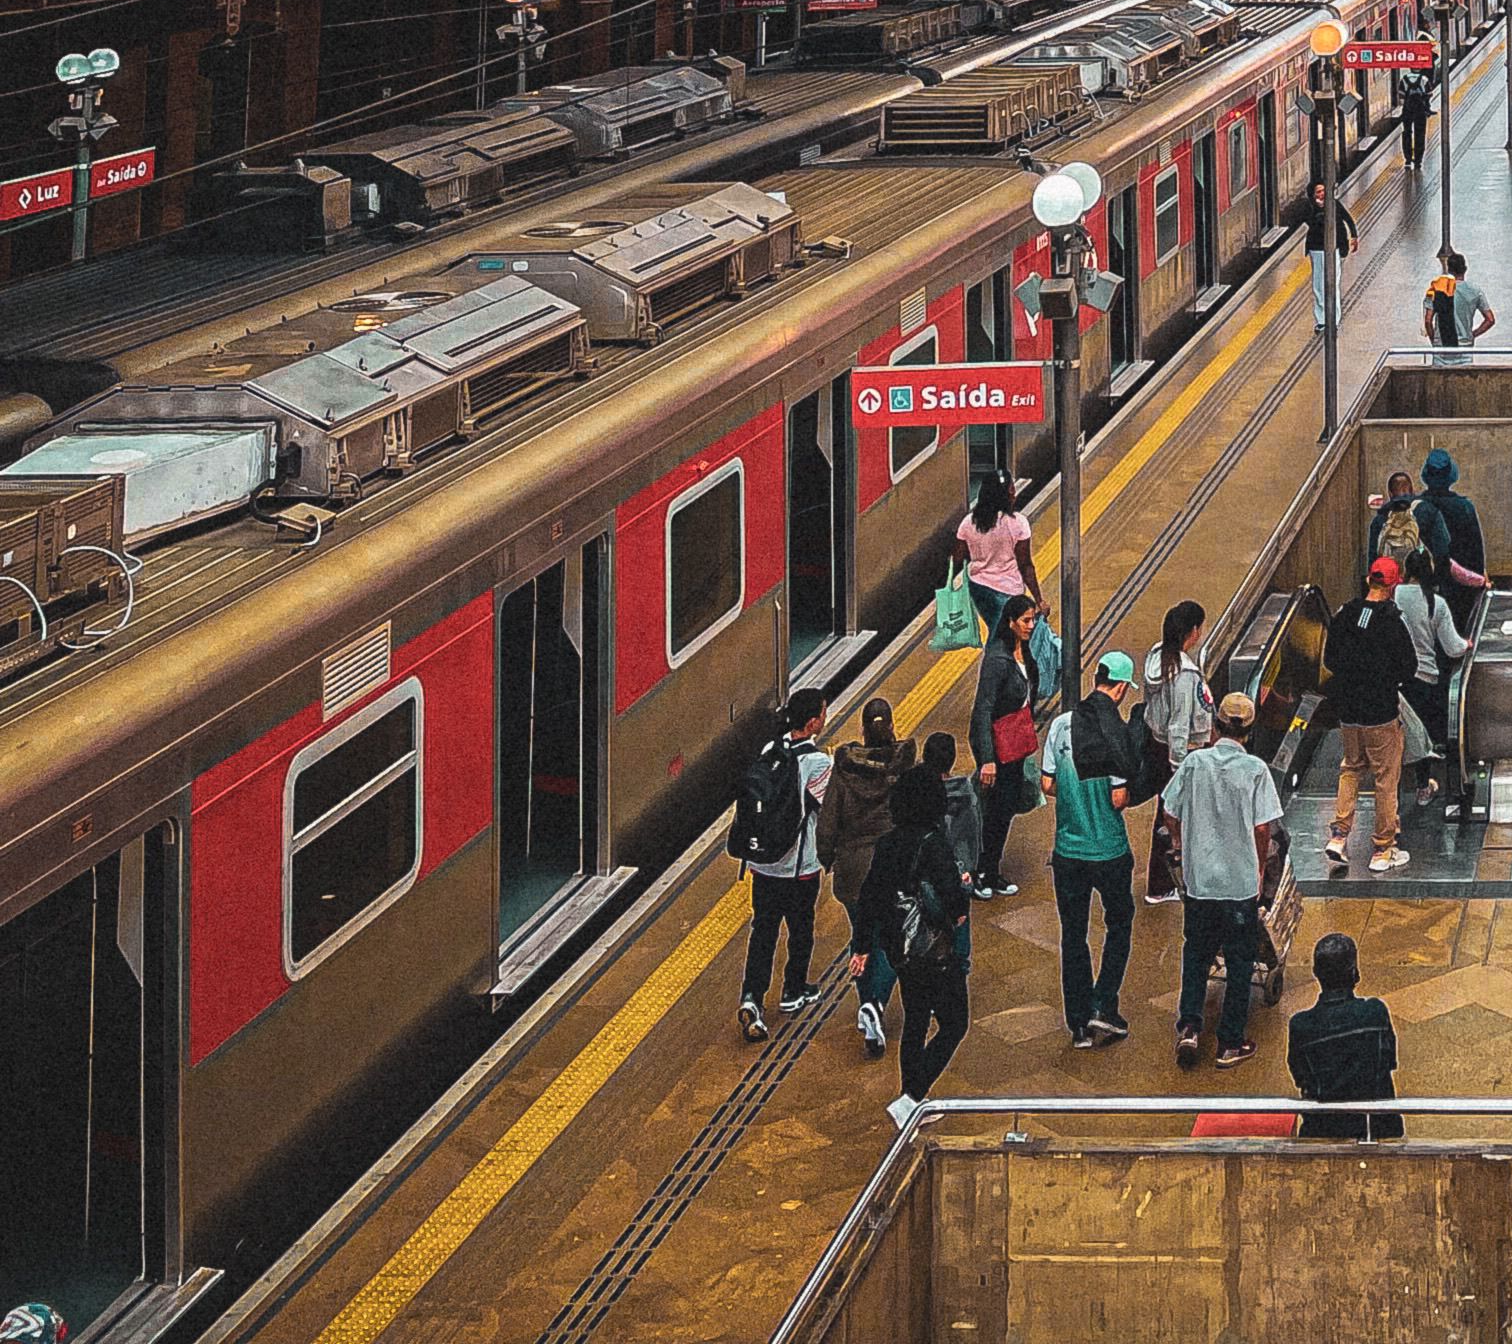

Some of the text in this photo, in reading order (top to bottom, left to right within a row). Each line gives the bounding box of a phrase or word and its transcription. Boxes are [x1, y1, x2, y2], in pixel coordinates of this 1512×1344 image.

[1375, 49, 1415, 62] Saída
[107, 165, 136, 185] Saída
[37, 185, 59, 202] Luz
[921, 383, 1036, 410] Saída Exit
